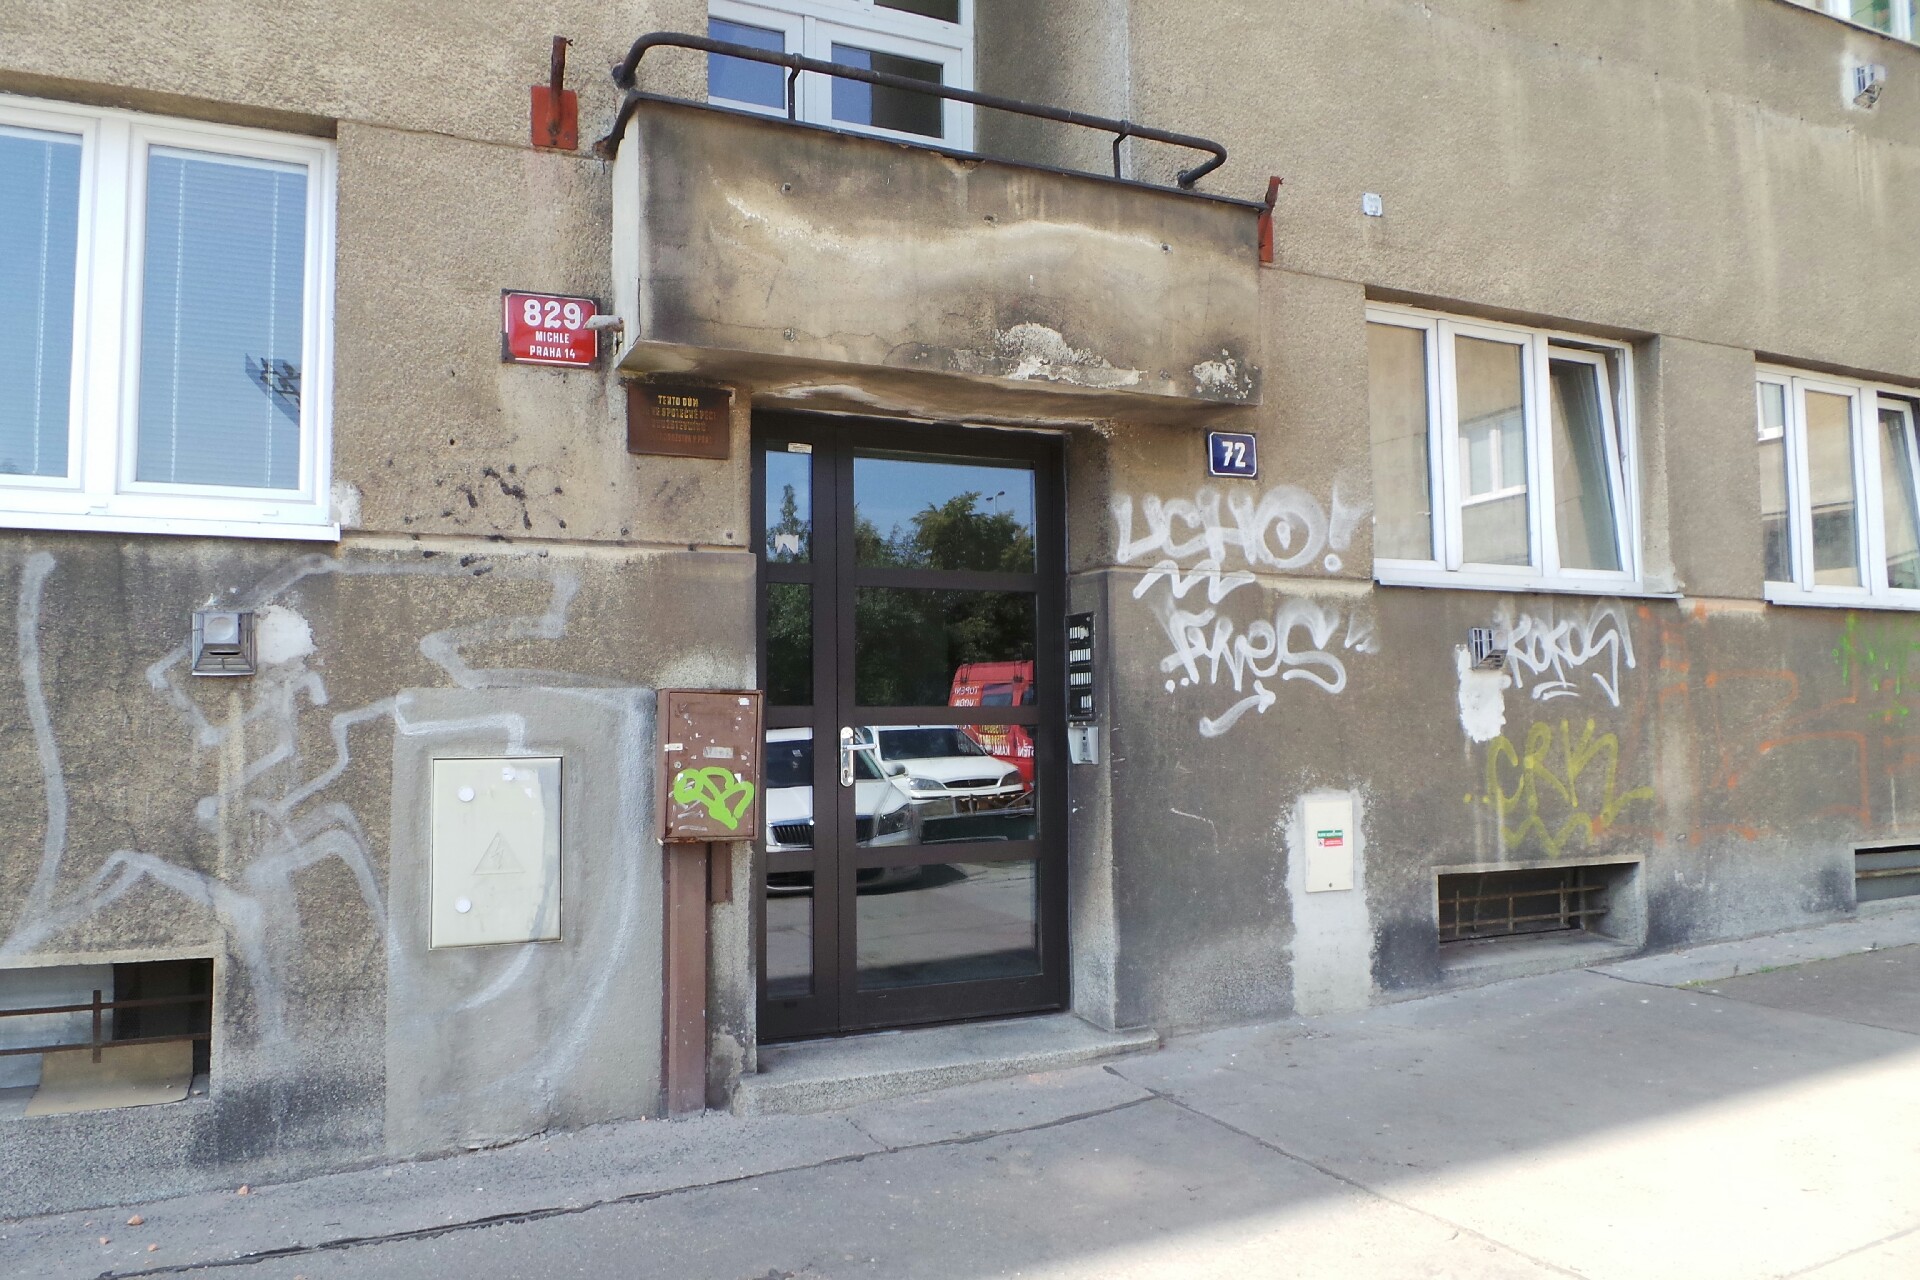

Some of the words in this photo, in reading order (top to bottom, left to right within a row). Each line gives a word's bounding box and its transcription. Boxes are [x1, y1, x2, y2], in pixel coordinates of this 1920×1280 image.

[523, 299, 581, 330] 829
[535, 331, 570, 344] MICHLE
[529, 345, 561, 358] PRAHA
[564, 348, 576, 359] 14
[658, 394, 681, 406] TENTO
[1222, 441, 1246, 467] 72
